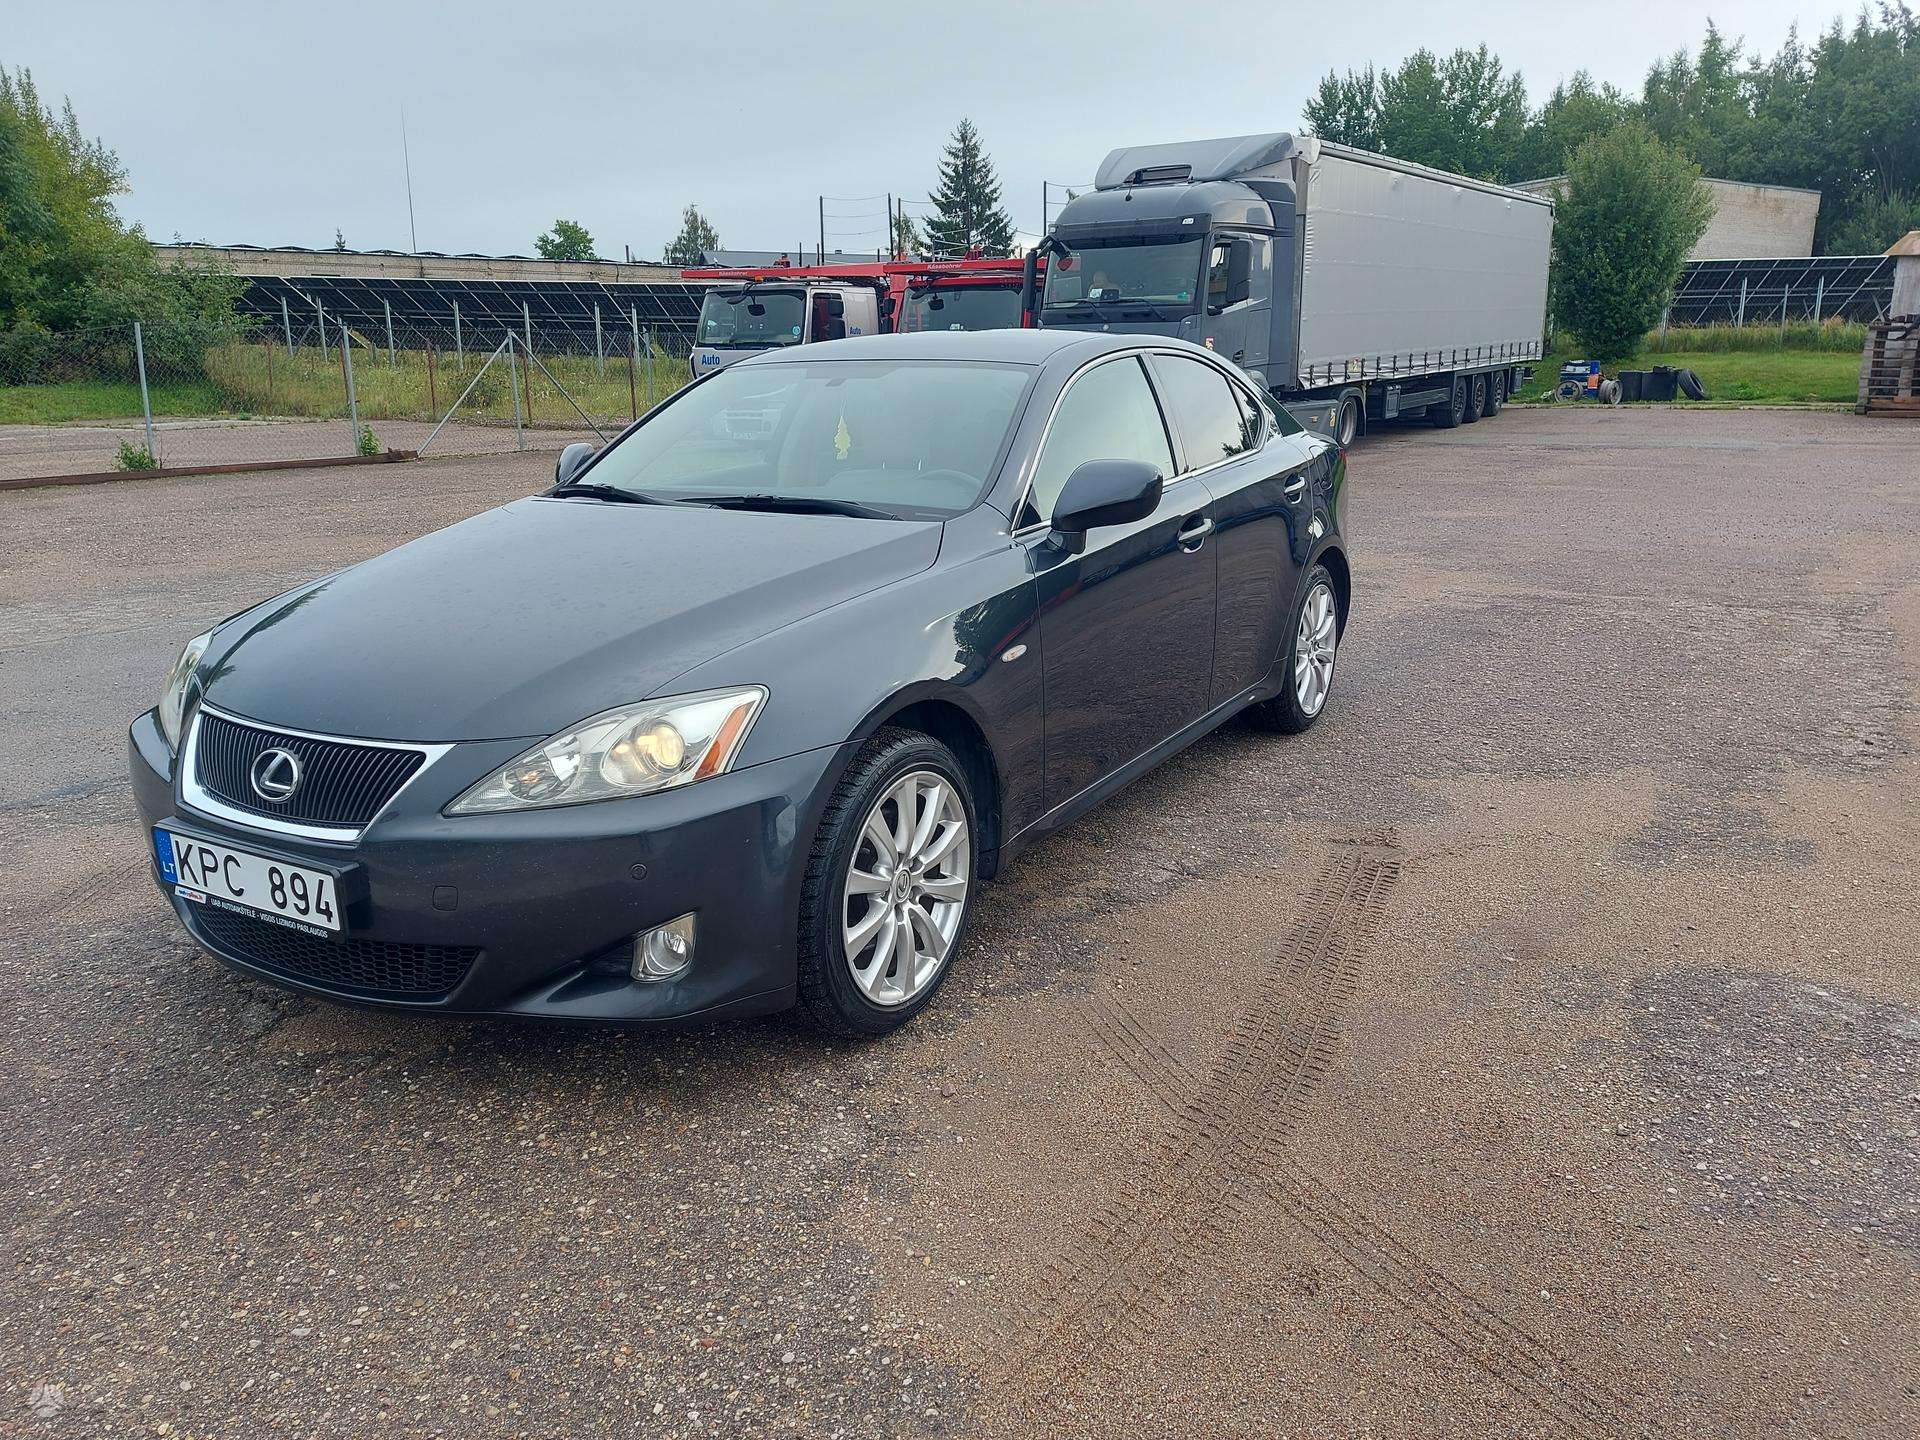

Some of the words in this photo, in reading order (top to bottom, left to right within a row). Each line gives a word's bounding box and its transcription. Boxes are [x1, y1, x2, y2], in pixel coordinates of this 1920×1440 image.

[849, 326, 862, 335] Auto
[701, 354, 720, 366] Auto
[162, 860, 175, 874] LT
[174, 840, 244, 897] KPC
[268, 866, 333, 923] 894
[296, 922, 328, 938] PASLAUGOS
